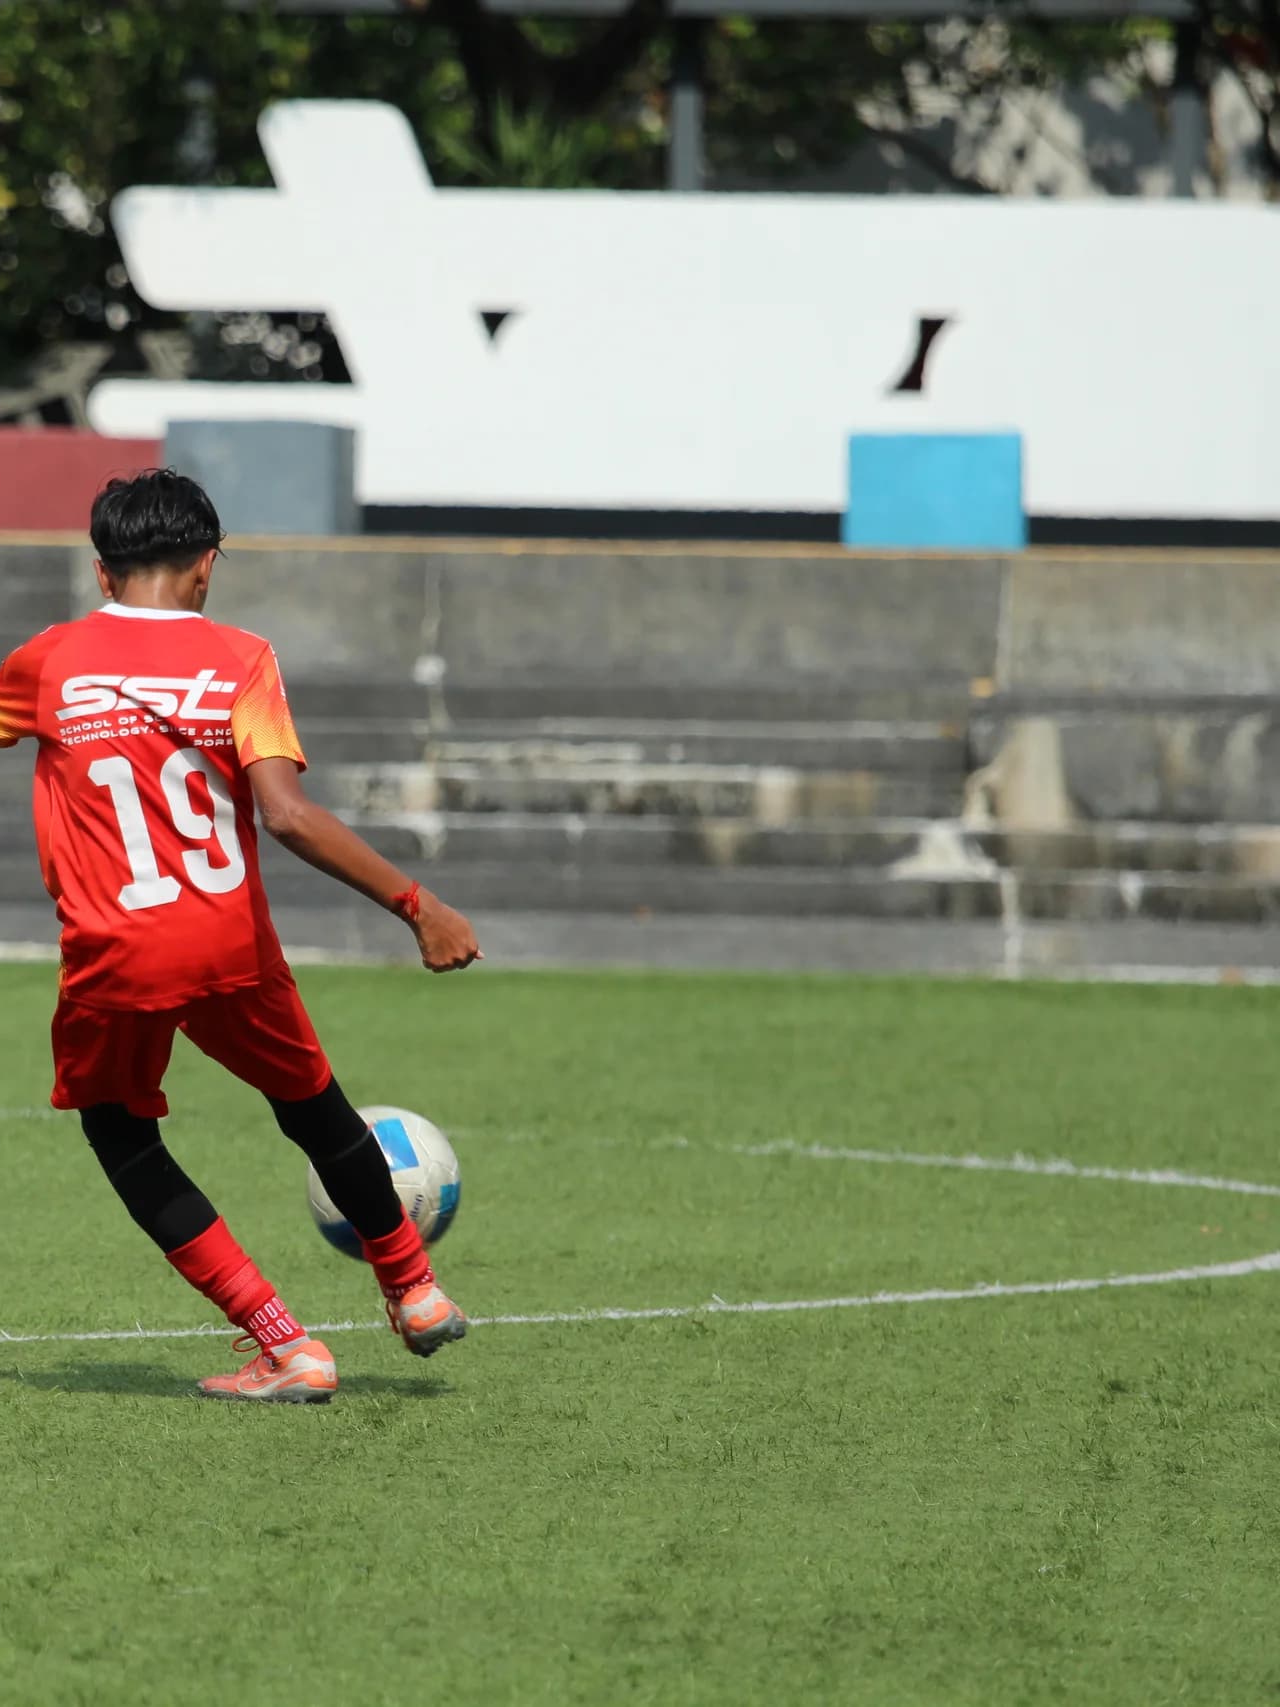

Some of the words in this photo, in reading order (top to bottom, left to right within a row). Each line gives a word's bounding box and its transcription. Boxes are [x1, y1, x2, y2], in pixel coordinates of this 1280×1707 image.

[59, 719, 112, 736] SCHOOL
[118, 715, 137, 725] OF
[61, 726, 154, 746] TECHNOLOGY,
[87, 747, 246, 911] 19
